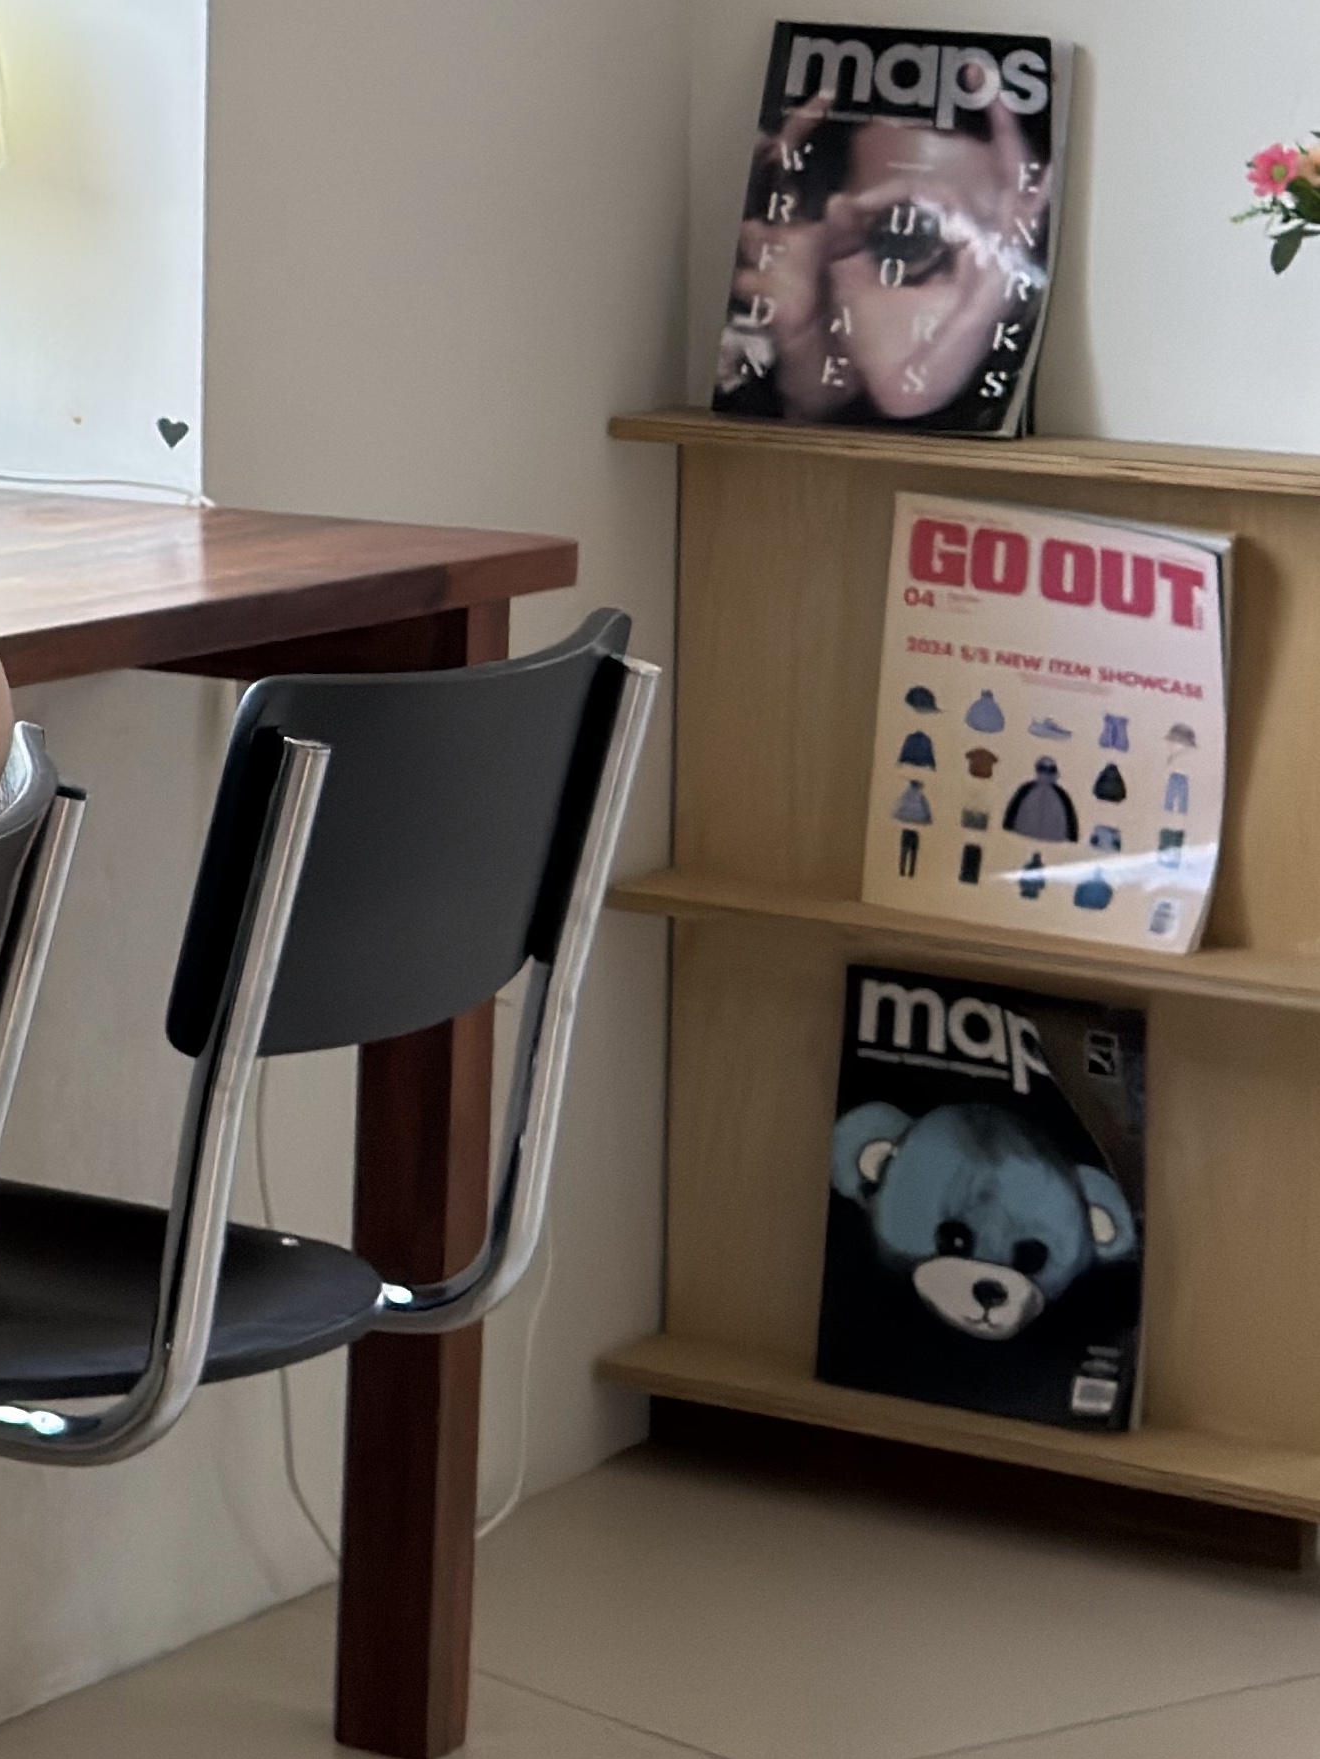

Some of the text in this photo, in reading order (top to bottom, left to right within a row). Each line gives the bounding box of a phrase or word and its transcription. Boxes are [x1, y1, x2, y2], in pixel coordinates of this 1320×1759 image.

[784, 35, 1048, 130] maps
[903, 586, 935, 608] 04
[910, 517, 1205, 629] GO OUT
[995, 649, 1043, 672] NEW
[1049, 656, 1092, 679] ITEM
[1098, 666, 1204, 700] SHOWCASE
